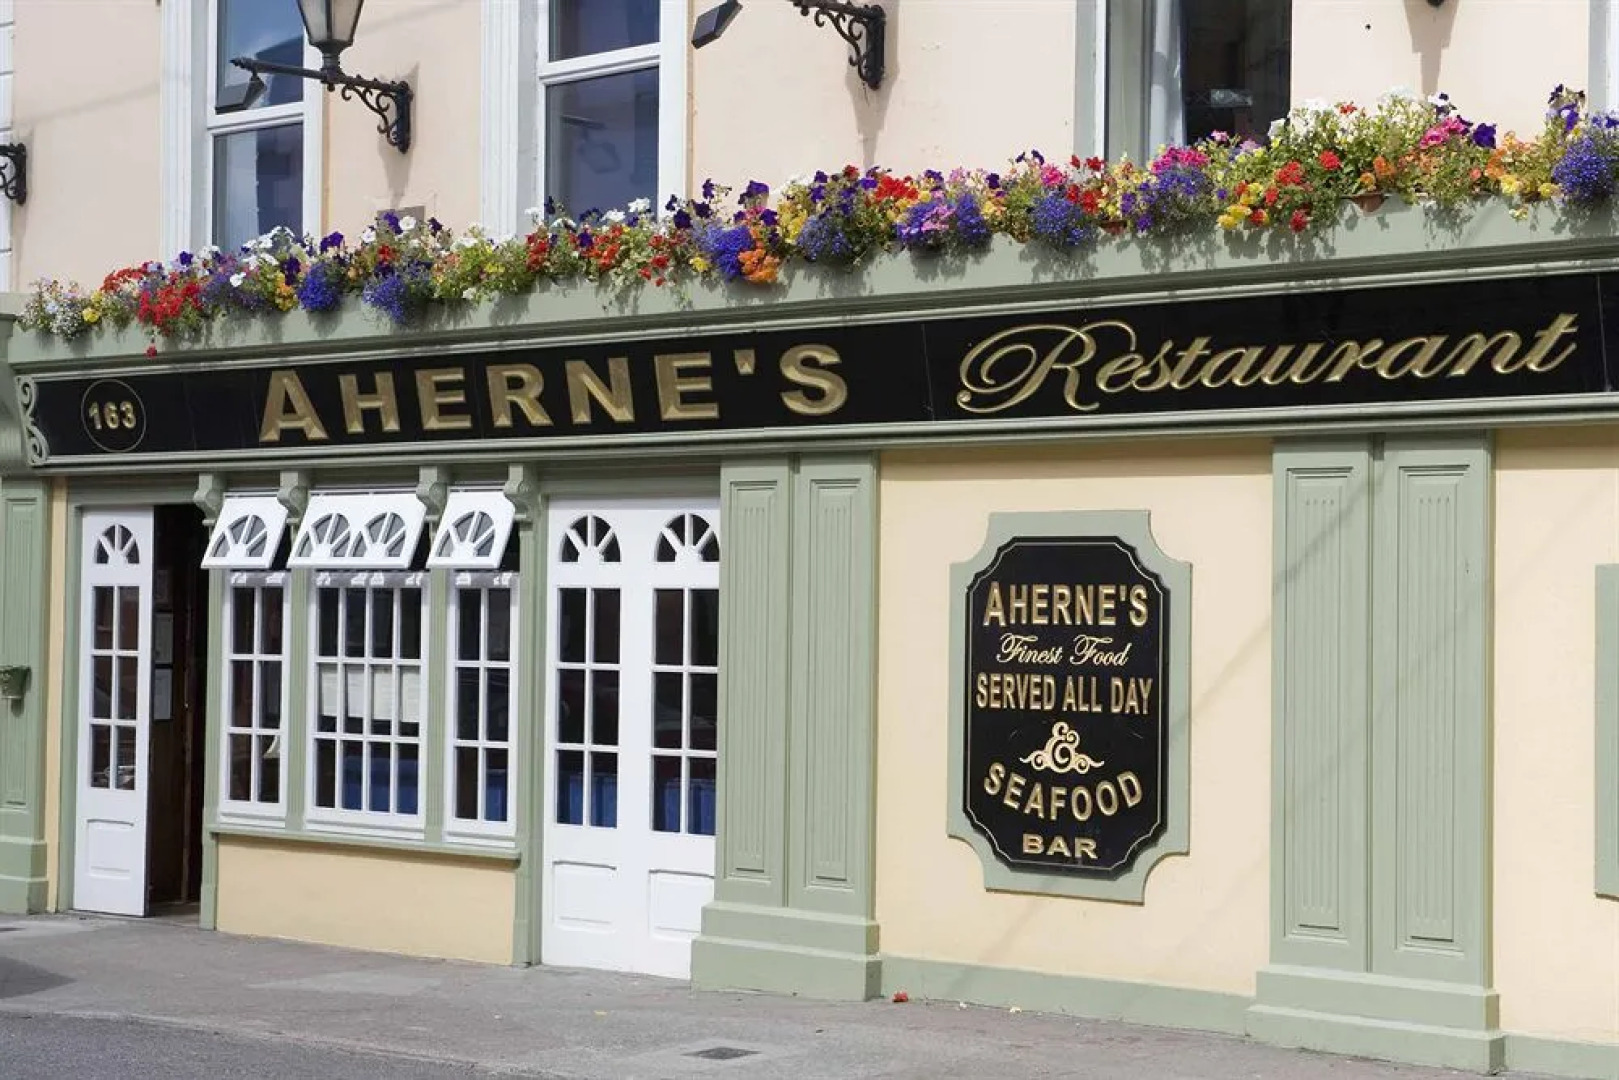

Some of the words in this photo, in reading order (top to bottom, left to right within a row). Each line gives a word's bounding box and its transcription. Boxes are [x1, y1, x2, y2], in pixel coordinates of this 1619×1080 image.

[257, 343, 849, 443] AHERNE'S
[956, 312, 1579, 414] Restaurant
[87, 400, 137, 430] 163
[983, 581, 1149, 627] AHERNE'S
[996, 632, 1062, 665] Finest
[1069, 633, 1131, 666] Food
[976, 672, 1056, 711] SERVED
[1062, 675, 1102, 713] ALL
[1110, 676, 1153, 715] DAY
[983, 761, 1143, 822] SEAFOOD
[1022, 833, 1098, 859] BAR
